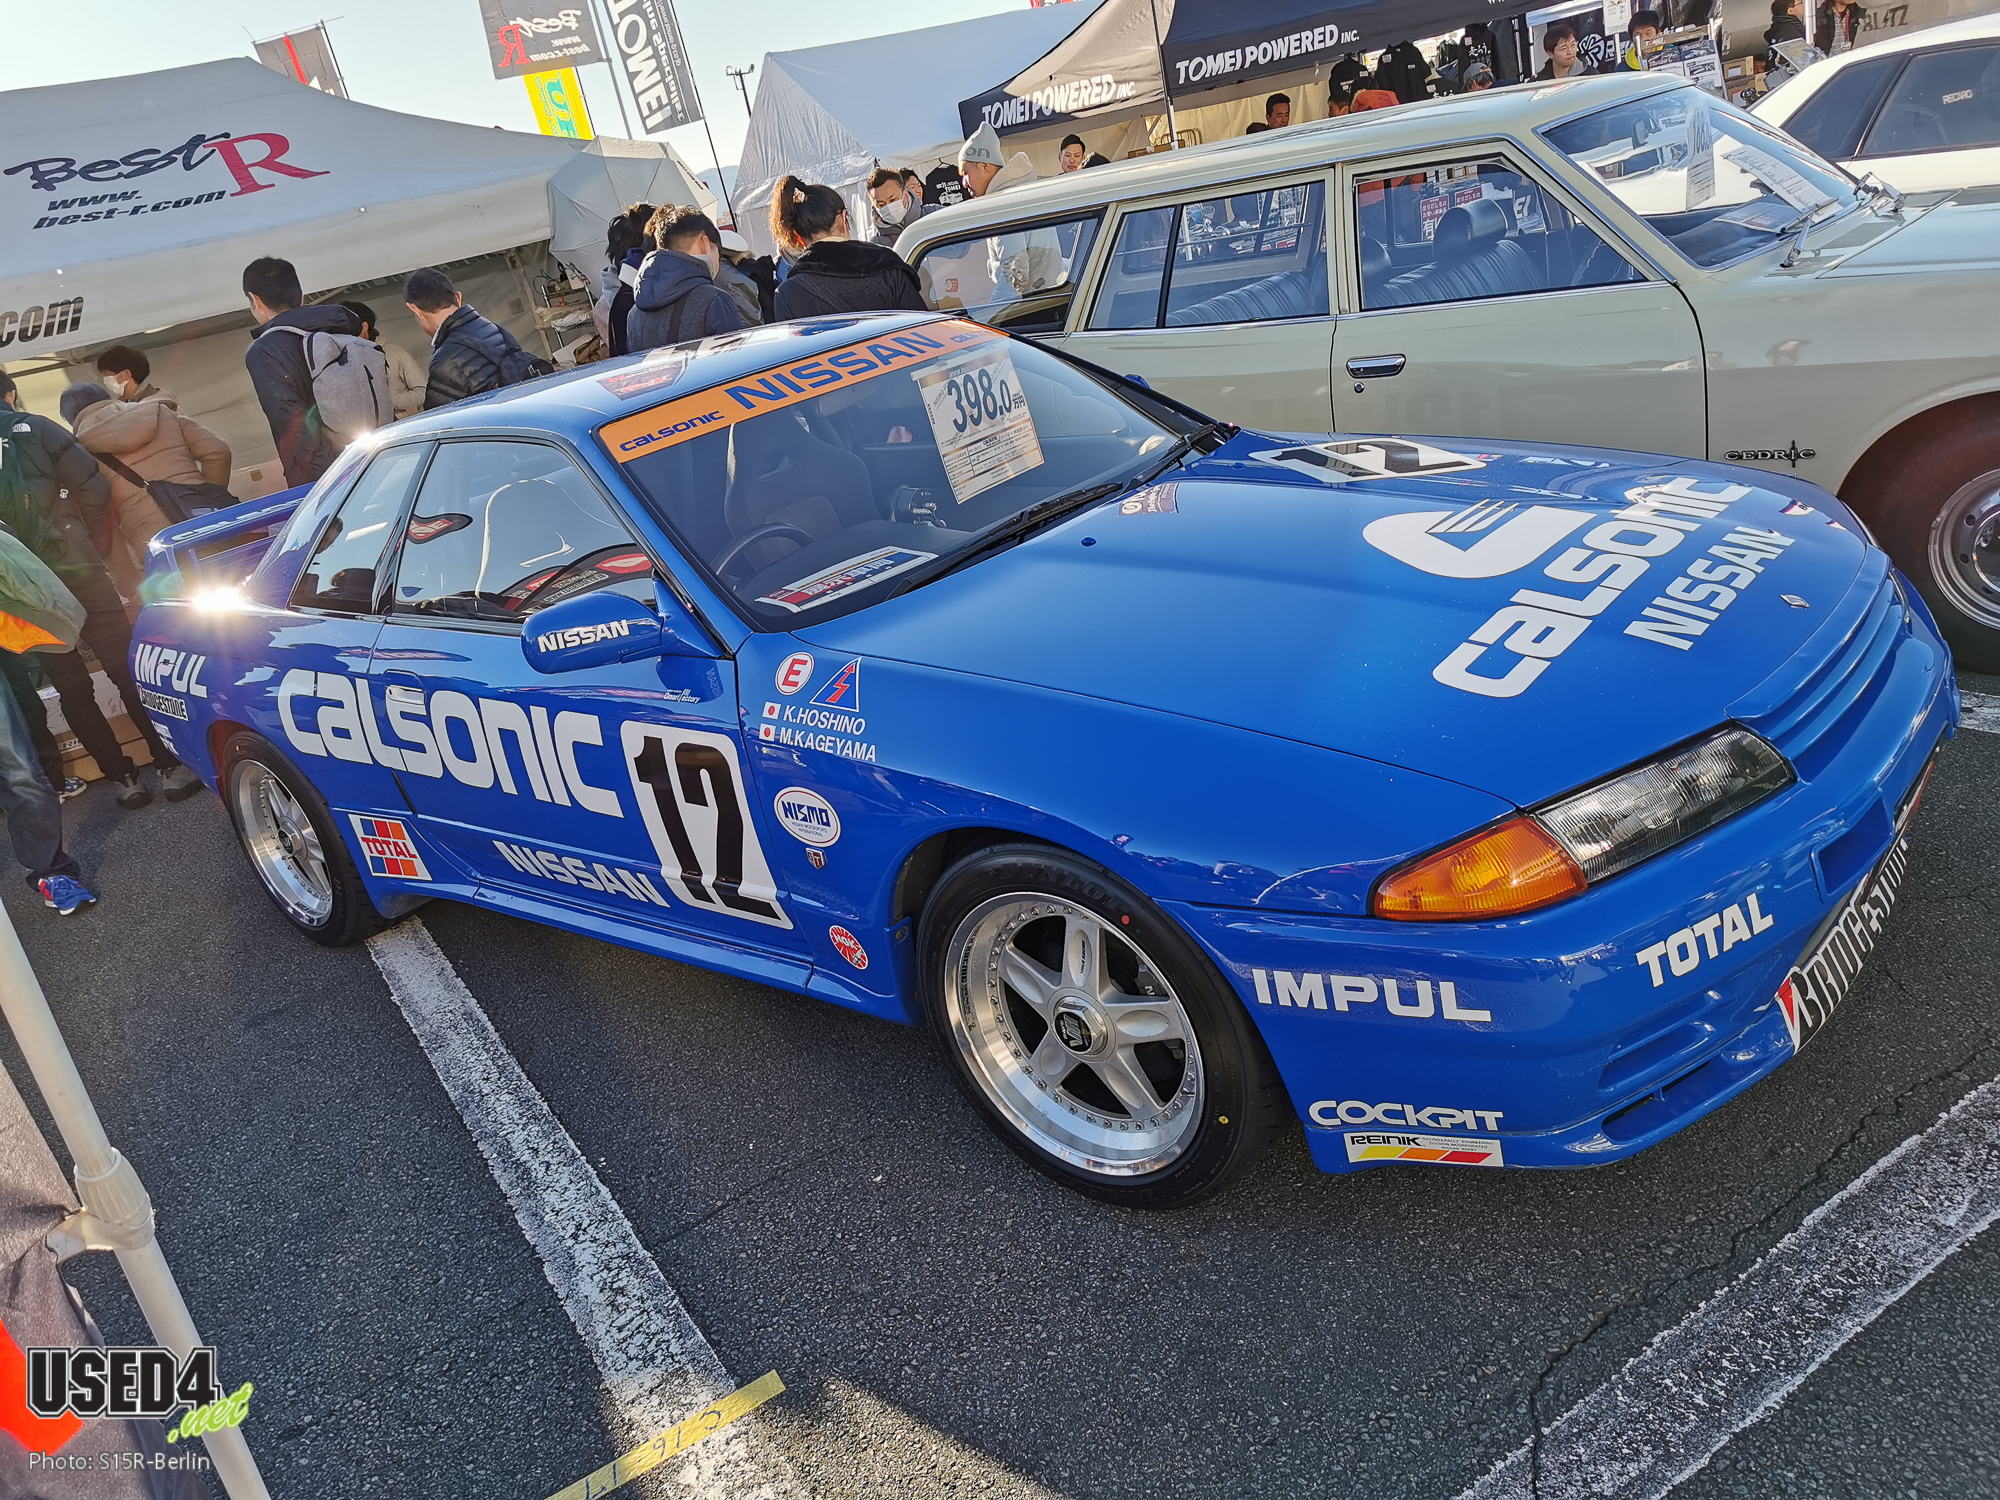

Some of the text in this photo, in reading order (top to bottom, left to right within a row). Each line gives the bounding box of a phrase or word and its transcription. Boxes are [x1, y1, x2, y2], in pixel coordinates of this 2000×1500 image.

[1175, 24, 1361, 86] TOMEI POWERED INC.
[981, 73, 1137, 129] TOMEI POWERED INC.
[1942, 88, 1974, 104] RECARO
[203, 132, 331, 197] R
[32, 189, 227, 230] best-r.com
[47, 189, 142, 212] www.
[723, 331, 945, 410] NISSAN
[1724, 444, 1816, 464] CEDRIC
[1623, 526, 1797, 652] NISSAN
[537, 619, 630, 653] NISSAN
[134, 643, 208, 699] IMPUL
[781, 658, 808, 688] E
[782, 706, 866, 736] K.HOSHINO
[778, 726, 877, 763] M.KAGEYAMA
[633, 736, 782, 921] 12
[781, 801, 831, 827] NISMO
[362, 837, 417, 859] TOTAL
[492, 840, 670, 908] NISSAN
[998, 861, 1133, 915] DUNLOP
[835, 934, 858, 950] NGK
[1635, 892, 1775, 988] TOTAL
[1252, 967, 1492, 1022] IMPUL
[1308, 1100, 1504, 1131] COCKPIT
[1350, 1135, 1422, 1147] REINIK
